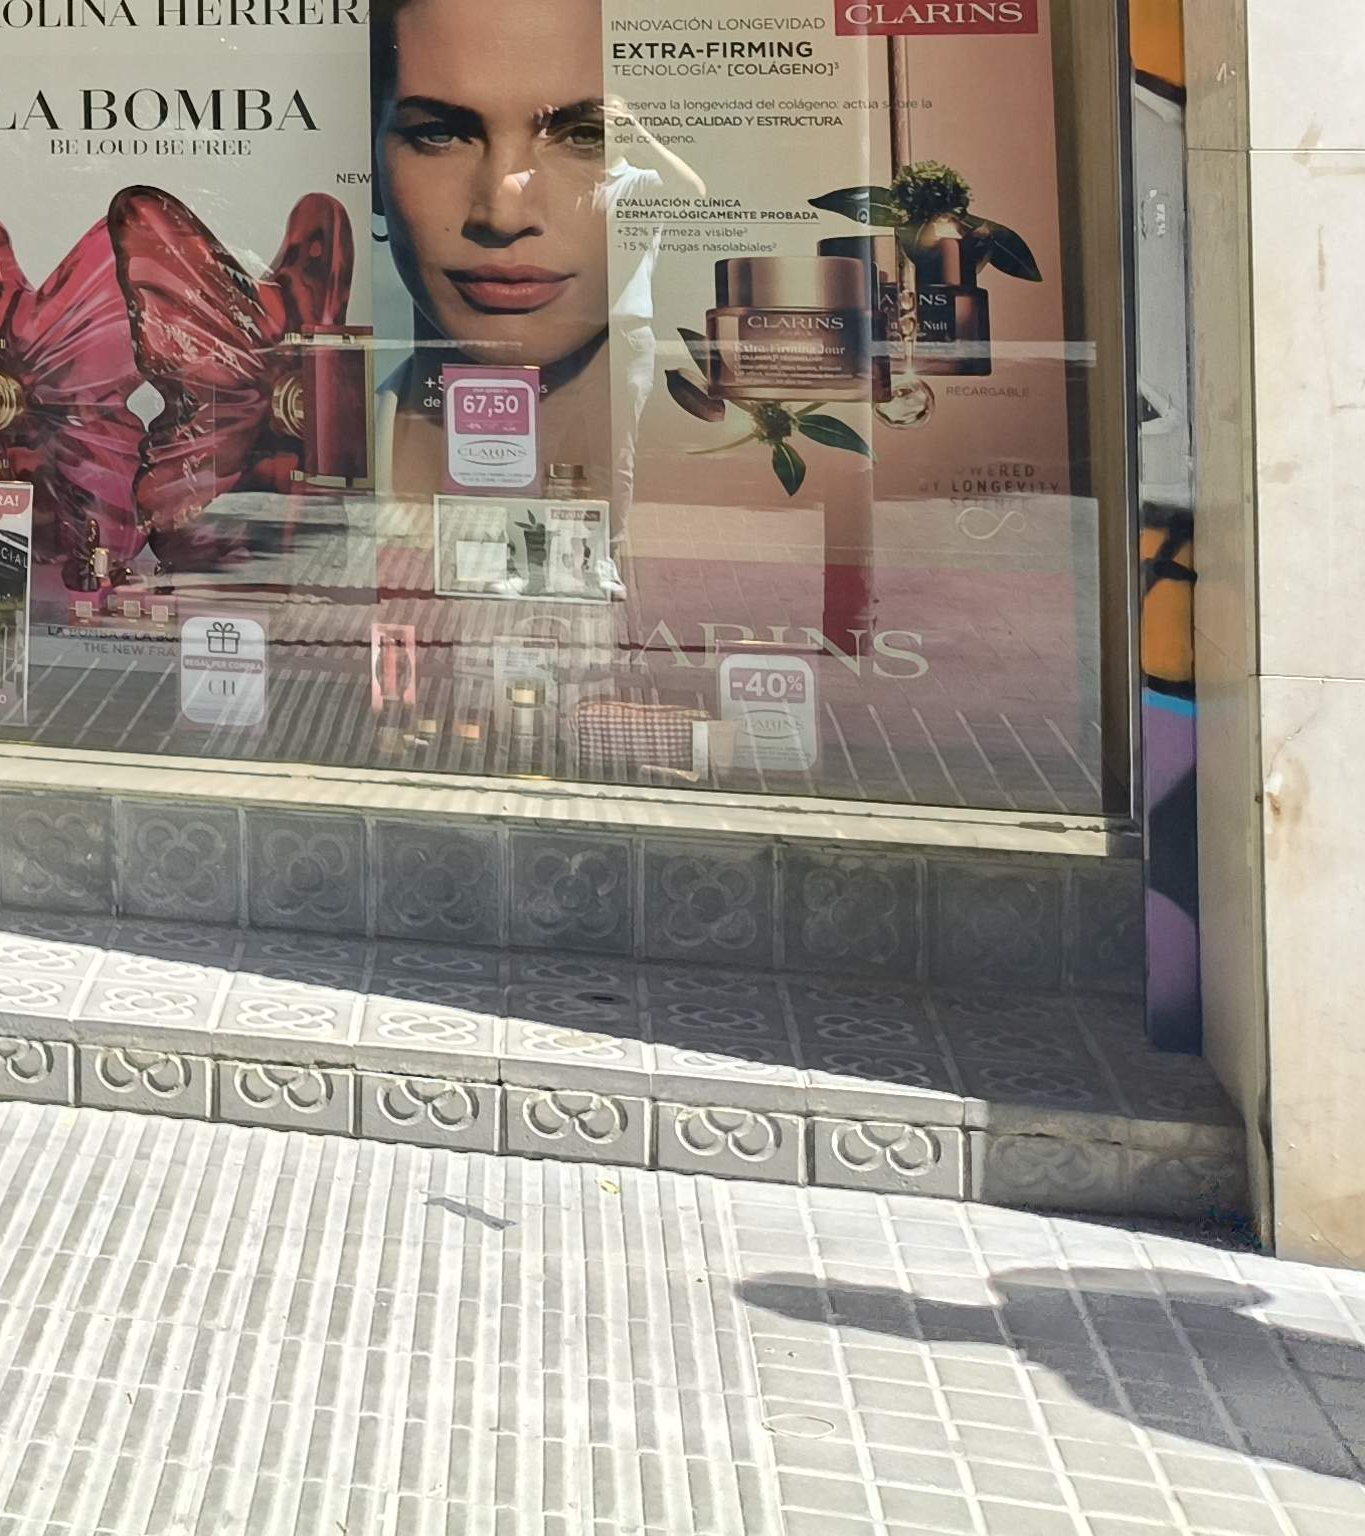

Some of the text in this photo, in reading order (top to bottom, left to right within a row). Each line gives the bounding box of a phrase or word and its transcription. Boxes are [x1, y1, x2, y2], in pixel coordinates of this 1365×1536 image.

[845, 2, 1022, 25] CLARINS
[611, 16, 825, 32] INNOVACIÓN LONGEVIDAD
[613, 41, 813, 59] EXTRA-FIRMING
[79, 88, 321, 131] BOMBA
[615, 99, 667, 110] reserva
[670, 98, 679, 110] la
[683, 98, 753, 113] longevidad
[756, 98, 775, 110] del
[882, 98, 917, 110] sbre
[921, 98, 933, 110] la
[685, 115, 742, 127] CALIDAD
[745, 115, 754, 127] Y
[757, 115, 843, 127] ESTRUCTURA
[614, 133, 634, 144] del
[50, 138, 251, 156] BE LOUD BE FREE
[335, 172, 371, 184] NEW
[616, 196, 741, 208] EVALUACIÓN CLÍNICA
[616, 209, 819, 220] DERMATOLÓGICAMENTE PROBADA
[618, 227, 648, 237] +32%
[748, 316, 844, 330] CLARINS
[923, 321, 948, 331] Nuit
[819, 344, 845, 355] Jour
[946, 385, 1029, 398] RECARGABLE
[423, 398, 441, 408] de
[463, 395, 519, 417] 67,50
[457, 446, 528, 458] CLARINS
[952, 480, 1059, 494] LONGEVITY
[47, 625, 63, 635] LA
[84, 642, 109, 653] THE
[112, 643, 145, 656] NEW
[731, 671, 803, 698] -40%
